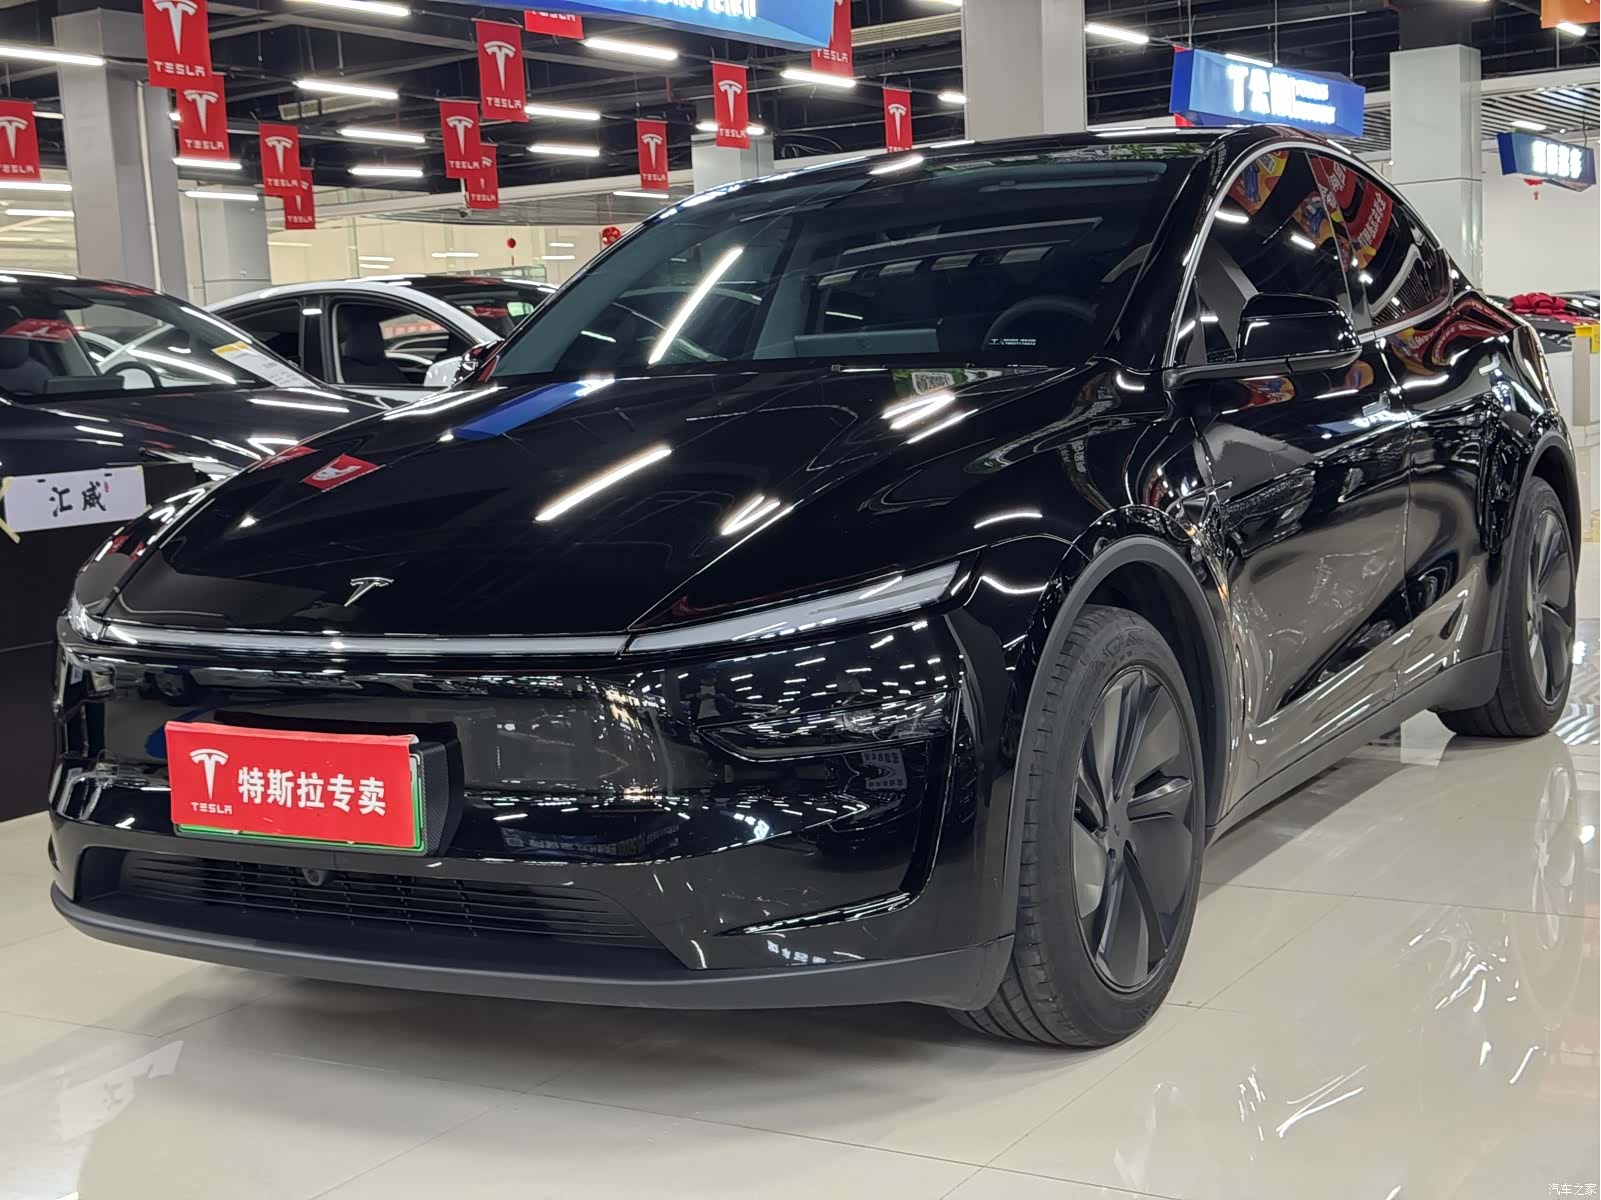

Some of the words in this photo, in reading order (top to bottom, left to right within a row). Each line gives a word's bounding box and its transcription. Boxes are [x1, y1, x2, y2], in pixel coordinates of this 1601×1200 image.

[817, 47, 849, 63] TESLA
[153, 60, 206, 77] TESLA
[486, 97, 523, 110] TESLA
[719, 127, 747, 138] TESLA
[185, 139, 224, 150] TESLA
[449, 160, 480, 169] TESLA
[266, 178, 298, 187] TESLA
[642, 173, 667, 181] TESLA
[469, 193, 497, 202] TESLA
[287, 215, 313, 223] TESLA
[49, 480, 106, 517] 汇威
[238, 767, 386, 816] 特斯拉专卖
[190, 801, 233, 815] TESLA
